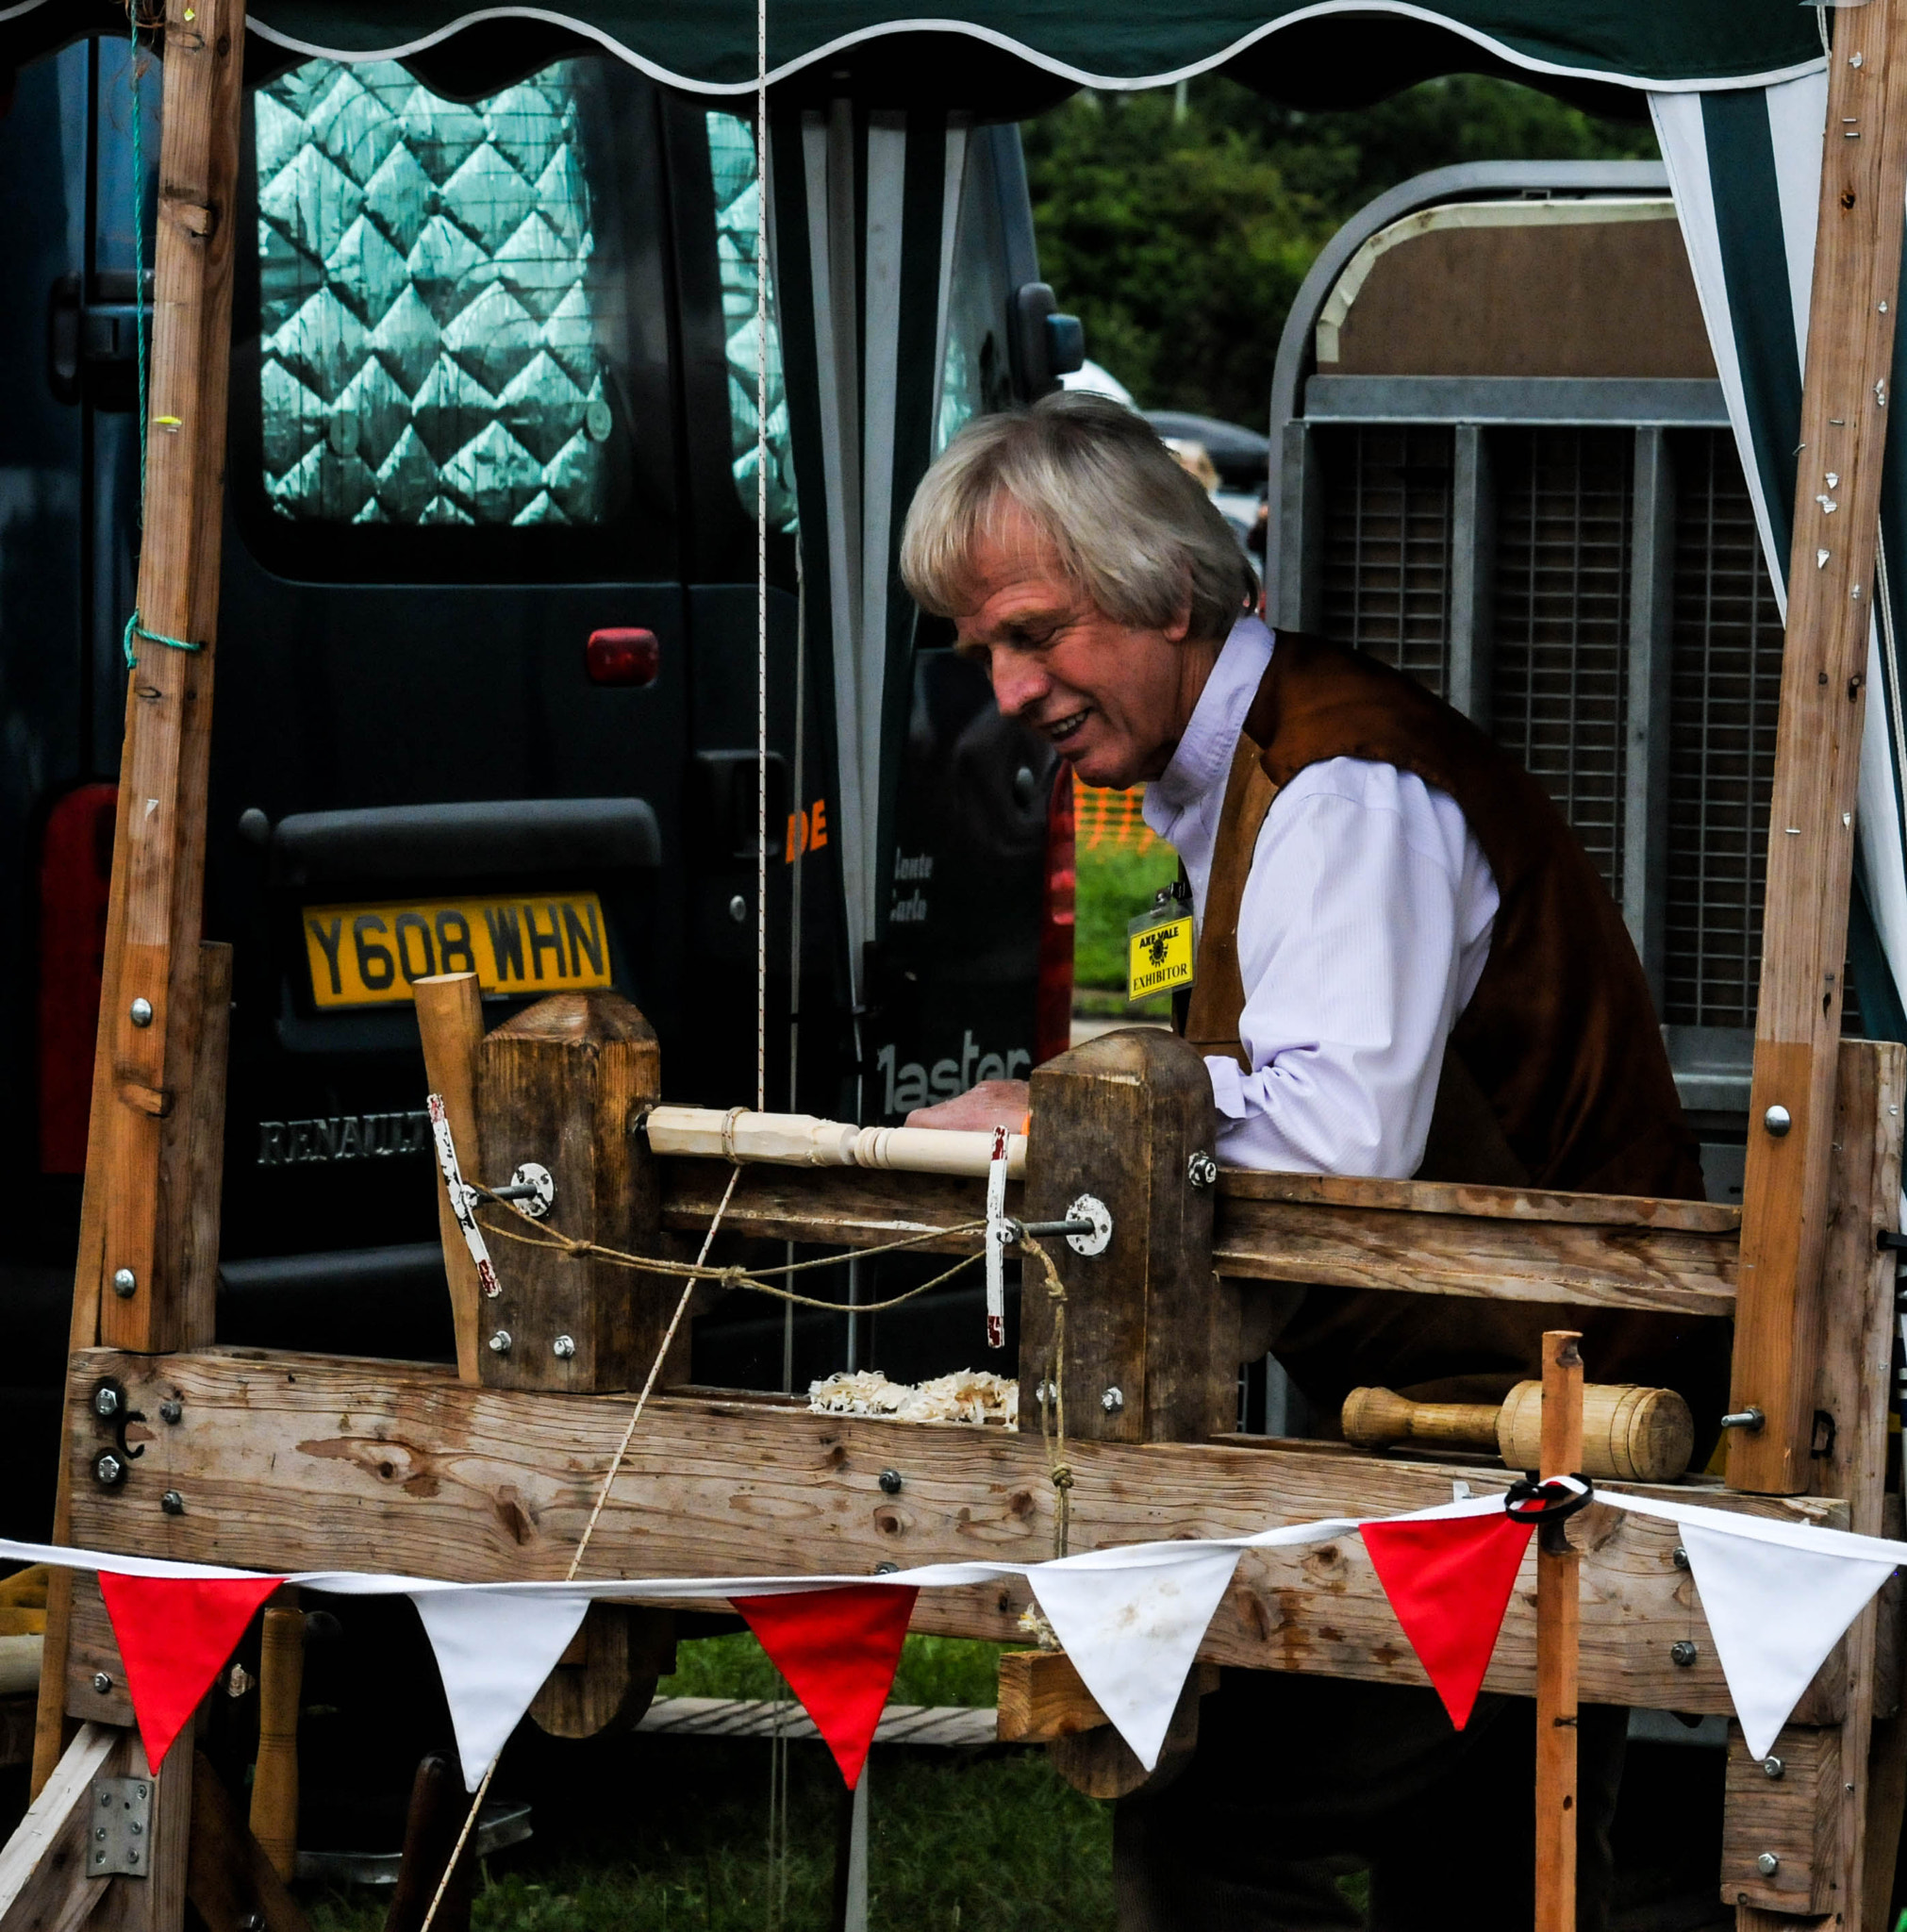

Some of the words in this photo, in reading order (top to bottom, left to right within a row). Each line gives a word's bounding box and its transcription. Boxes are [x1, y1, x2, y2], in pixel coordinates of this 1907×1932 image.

[895, 846, 933, 880] onte
[308, 908, 476, 995] Y608
[484, 903, 605, 982] WHN
[1139, 934, 1155, 949] AXE
[1157, 926, 1179, 941] VALE
[1133, 963, 1187, 991] EXHIBITOR
[257, 1111, 428, 1164] RENAULT
